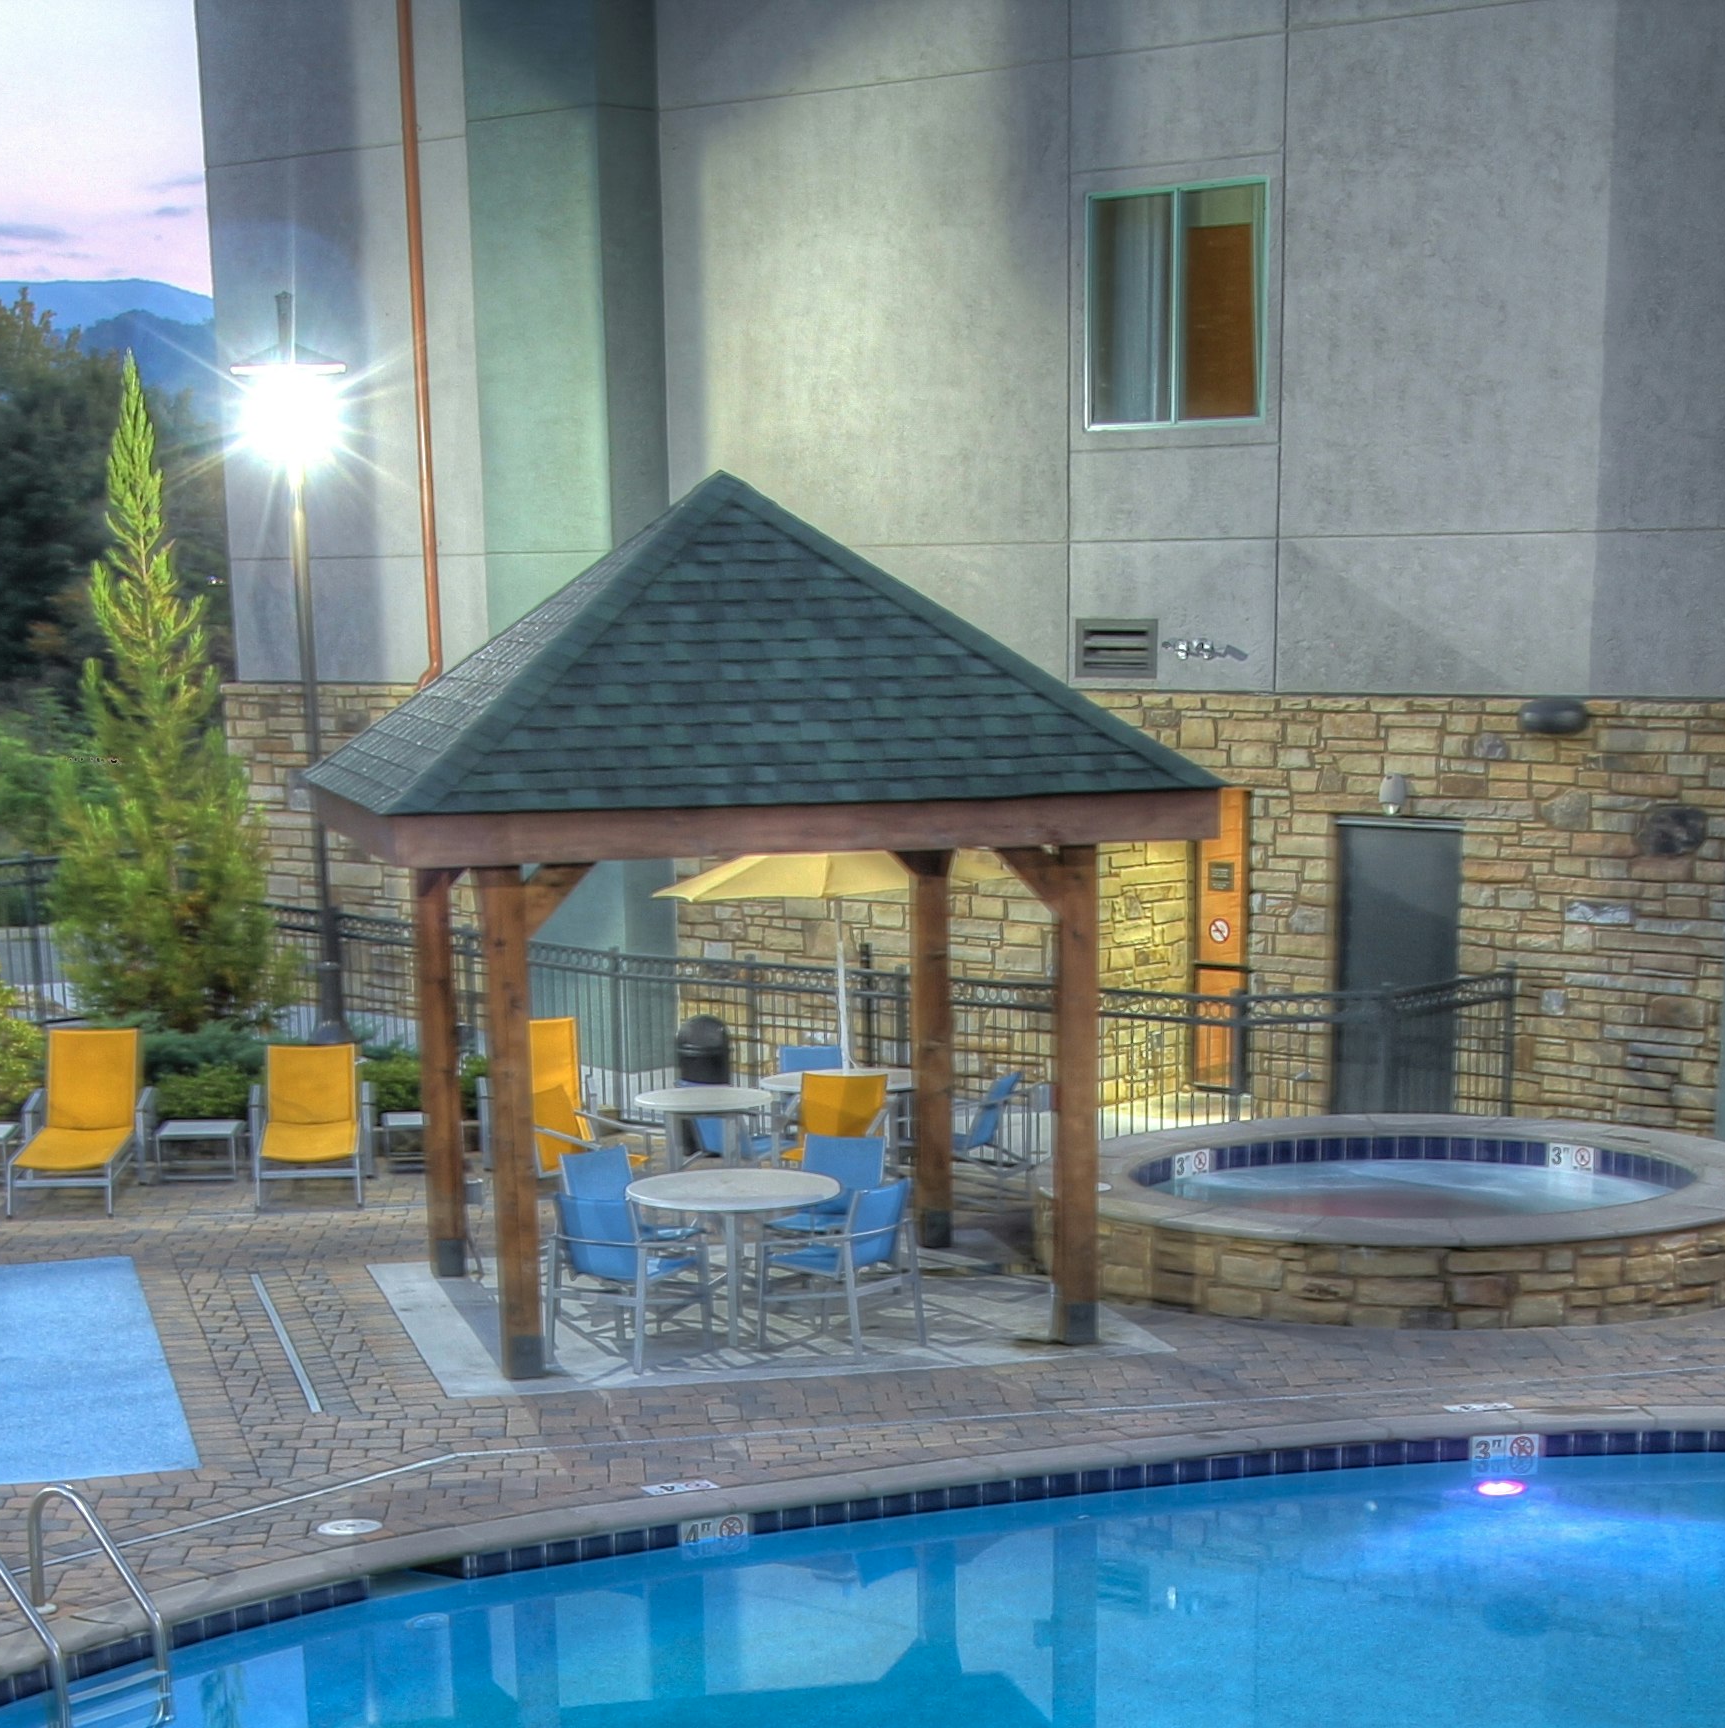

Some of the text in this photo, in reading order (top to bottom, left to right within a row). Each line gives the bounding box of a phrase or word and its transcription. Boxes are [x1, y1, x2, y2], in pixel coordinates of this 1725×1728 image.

[1551, 1146, 1562, 1165] 3
[1176, 1156, 1185, 1176] 3
[1475, 1439, 1502, 1460] 3 FT
[684, 1521, 712, 1544] 4 FT
